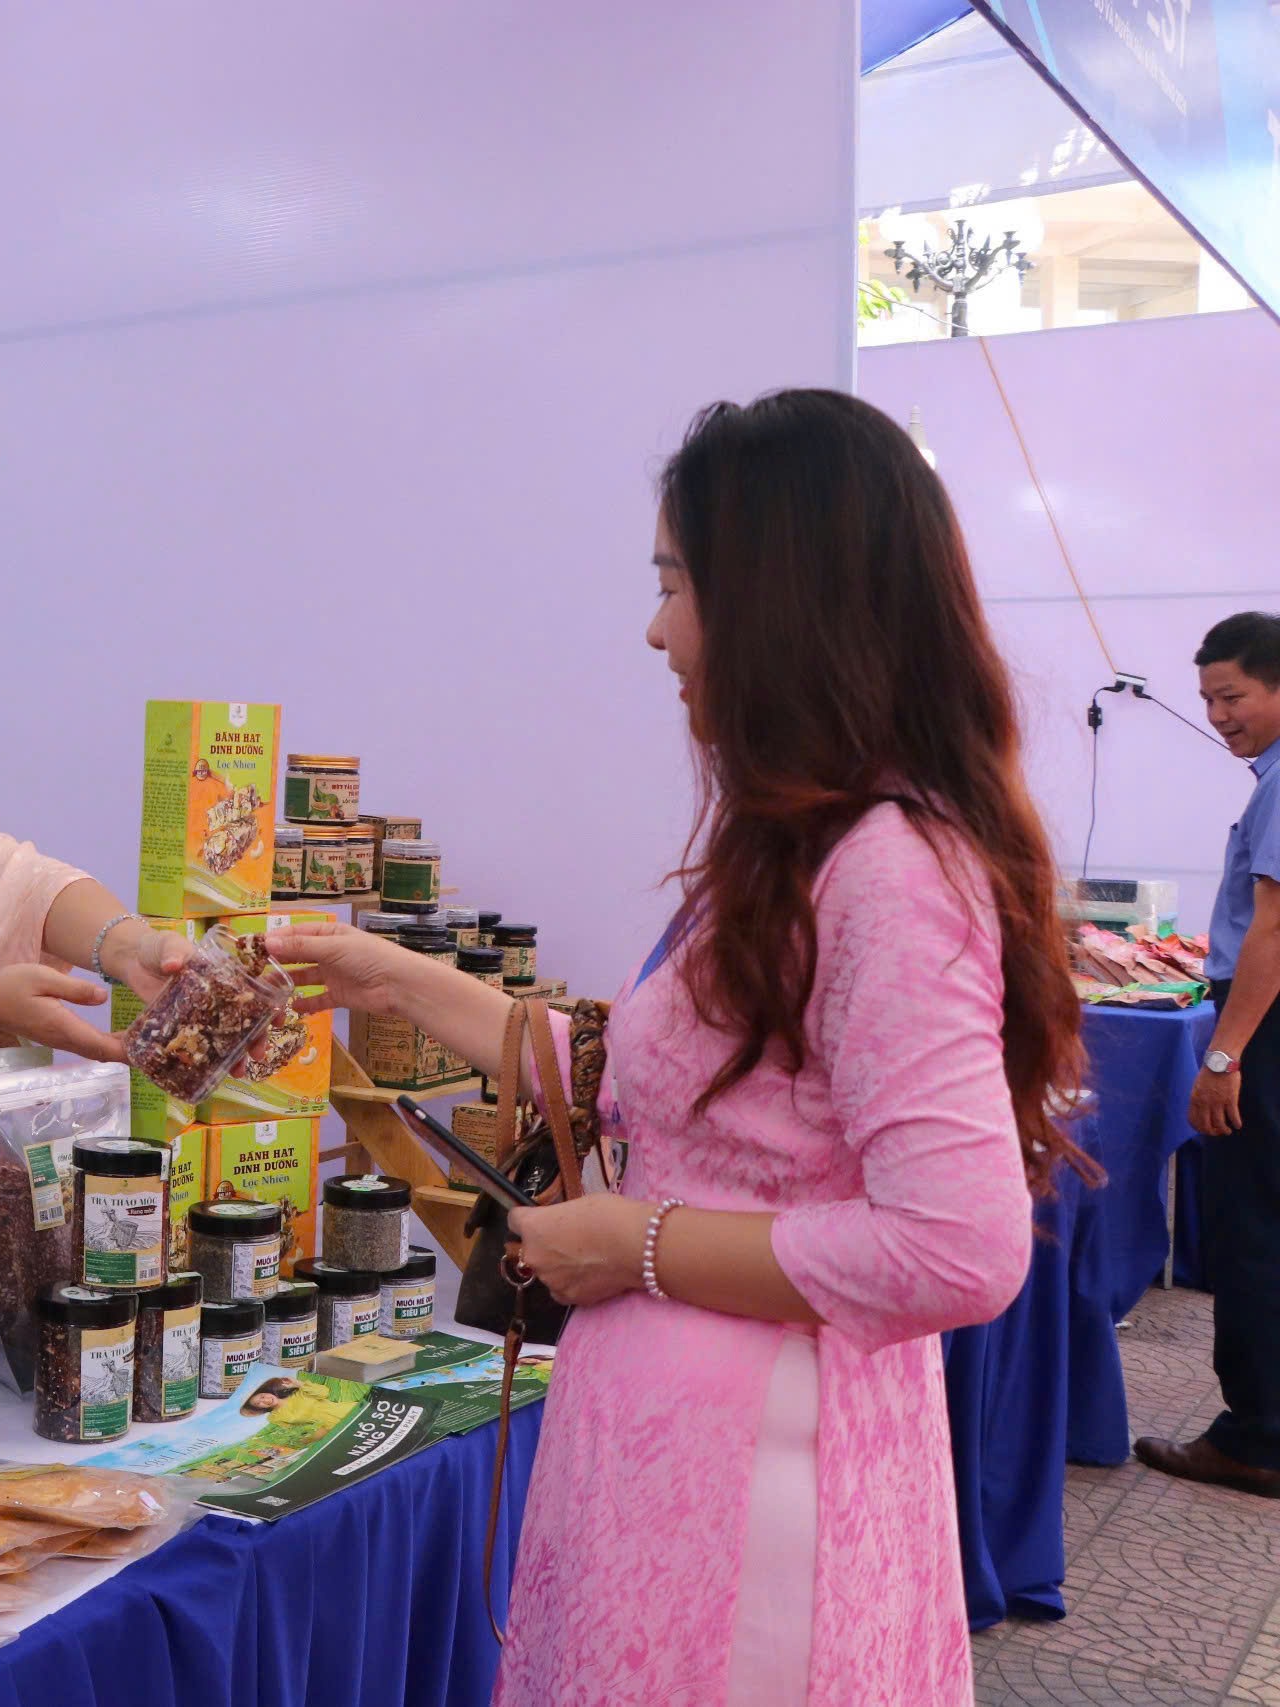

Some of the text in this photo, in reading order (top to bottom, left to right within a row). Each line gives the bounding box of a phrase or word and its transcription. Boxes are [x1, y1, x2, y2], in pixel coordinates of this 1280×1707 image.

[233, 1164, 260, 1176] DINH
[347, 1431, 386, 1456] NĂNG
[380, 1403, 406, 1429] LỰC
[353, 1422, 376, 1438] HỒ
[371, 1400, 391, 1420] SƠ
